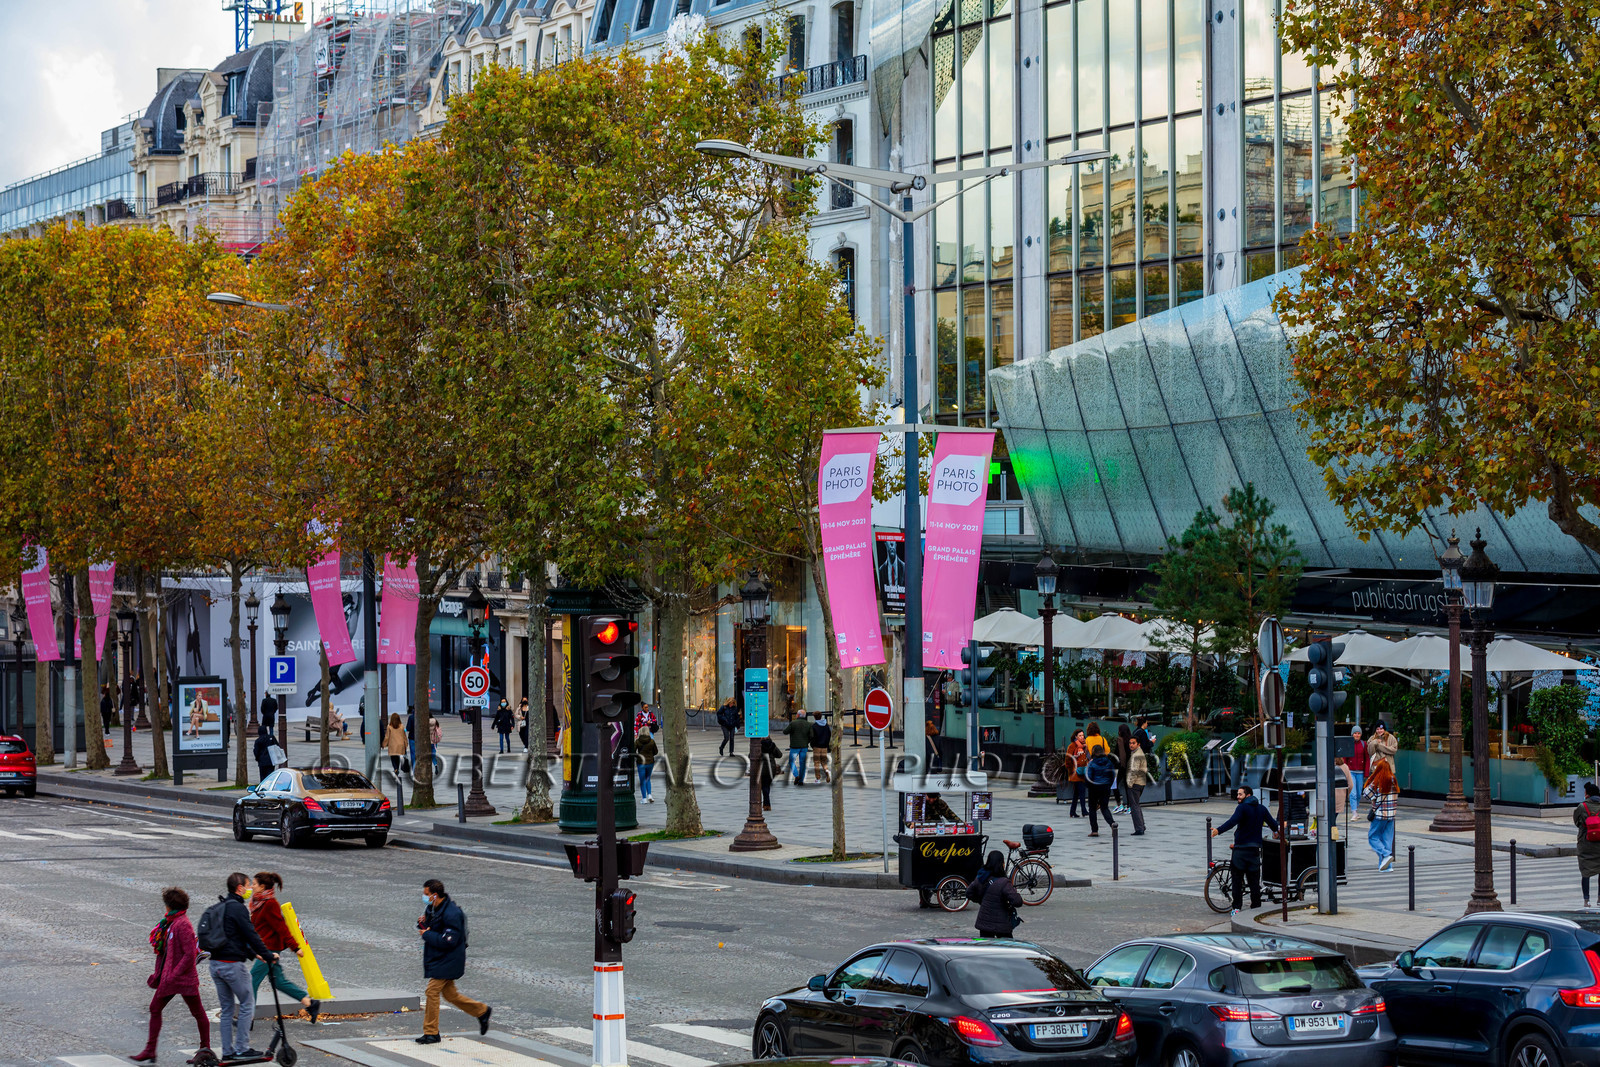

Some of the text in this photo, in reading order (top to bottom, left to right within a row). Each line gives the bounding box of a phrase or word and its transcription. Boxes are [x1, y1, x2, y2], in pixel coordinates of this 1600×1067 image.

[829, 466, 861, 478] PARIS
[942, 467, 976, 480] PARIS
[825, 478, 864, 491] PHOTO
[936, 480, 978, 493] PHOTO
[836, 520, 850, 528] NOV
[852, 518, 866, 526] 2021
[962, 524, 979, 532] 2021
[824, 542, 867, 553] GRAND PALAIS
[927, 545, 976, 556] GRAND PALAIS
[439, 597, 463, 617] Orange
[276, 662, 288, 679] P
[467, 676, 484, 689] 50
[920, 841, 975, 863] Crepes
[1295, 1017, 1338, 1028] DW-953-LW
[1036, 1023, 1080, 1035] FP-386-XT
